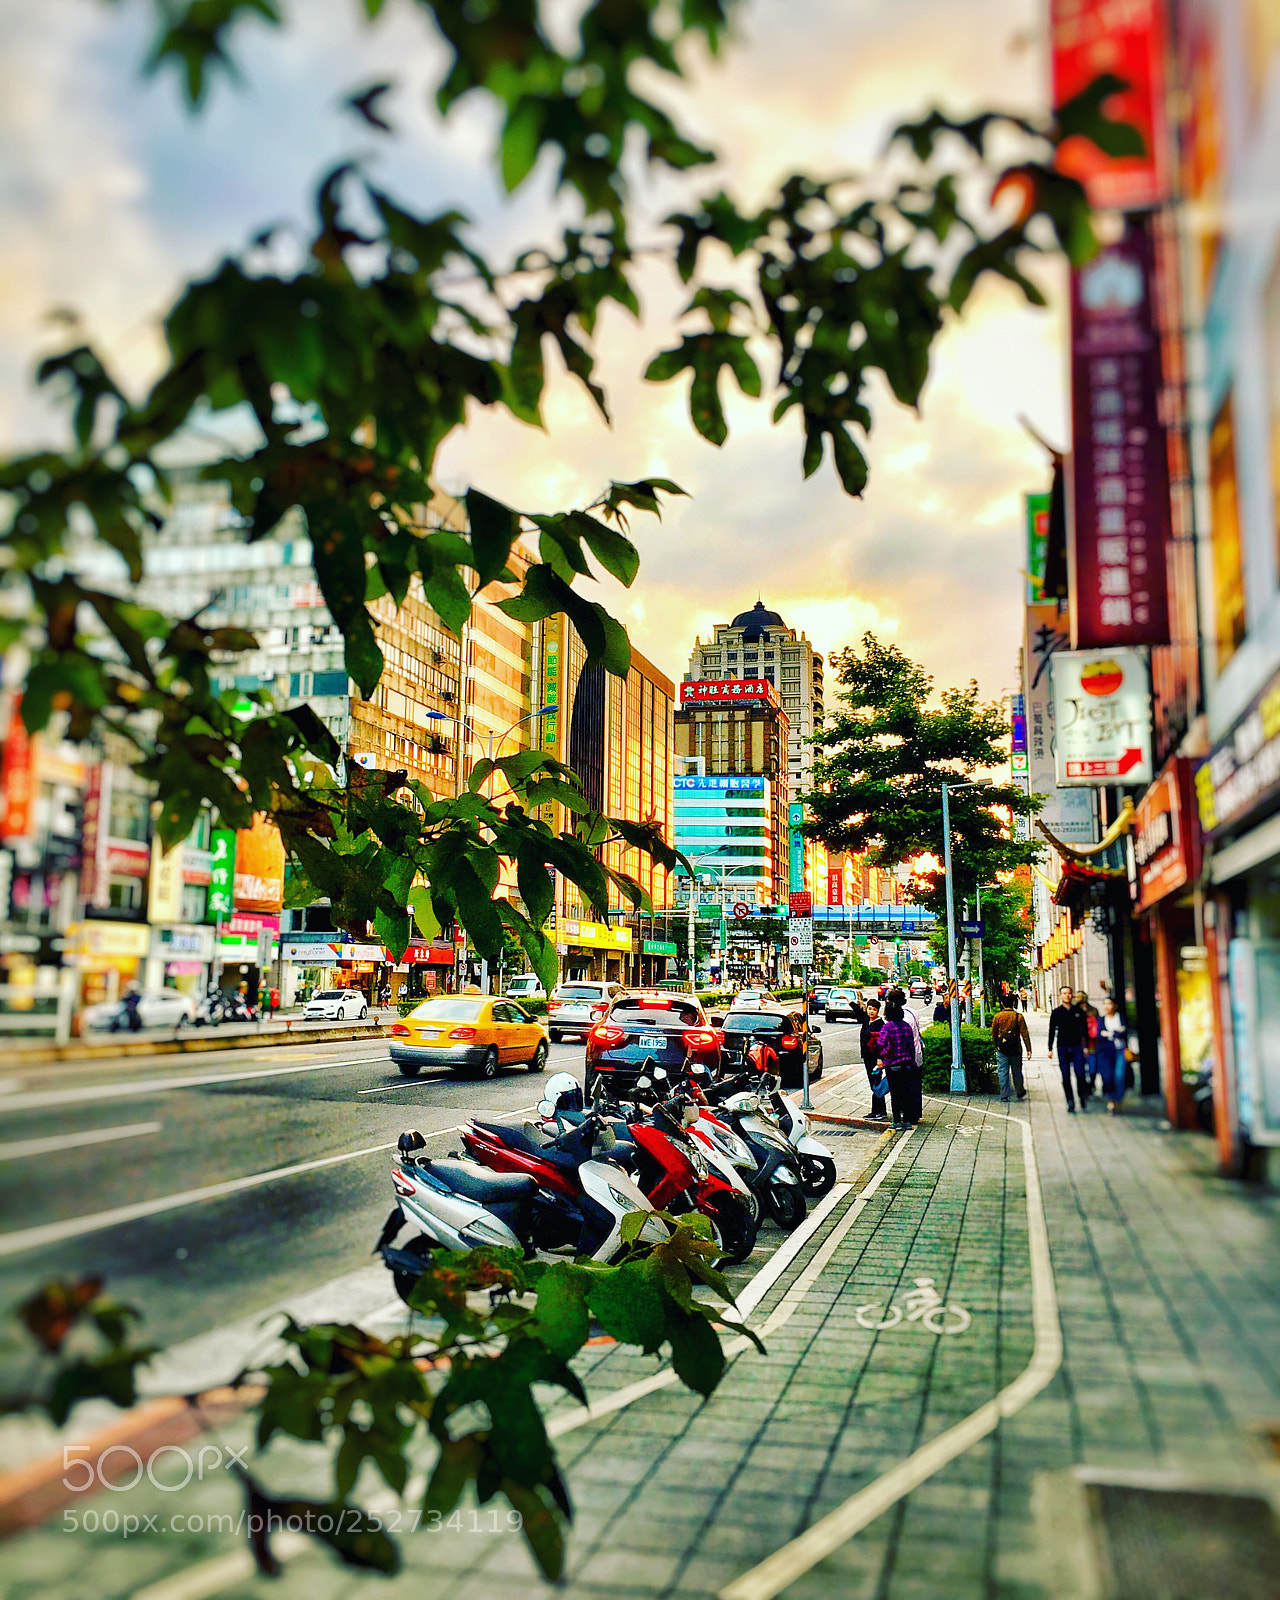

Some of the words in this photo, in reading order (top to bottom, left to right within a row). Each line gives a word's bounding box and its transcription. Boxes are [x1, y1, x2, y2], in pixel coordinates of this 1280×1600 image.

[698, 683, 764, 696] 神旺商務酒店
[697, 778, 762, 789] 先進細胞醫學
